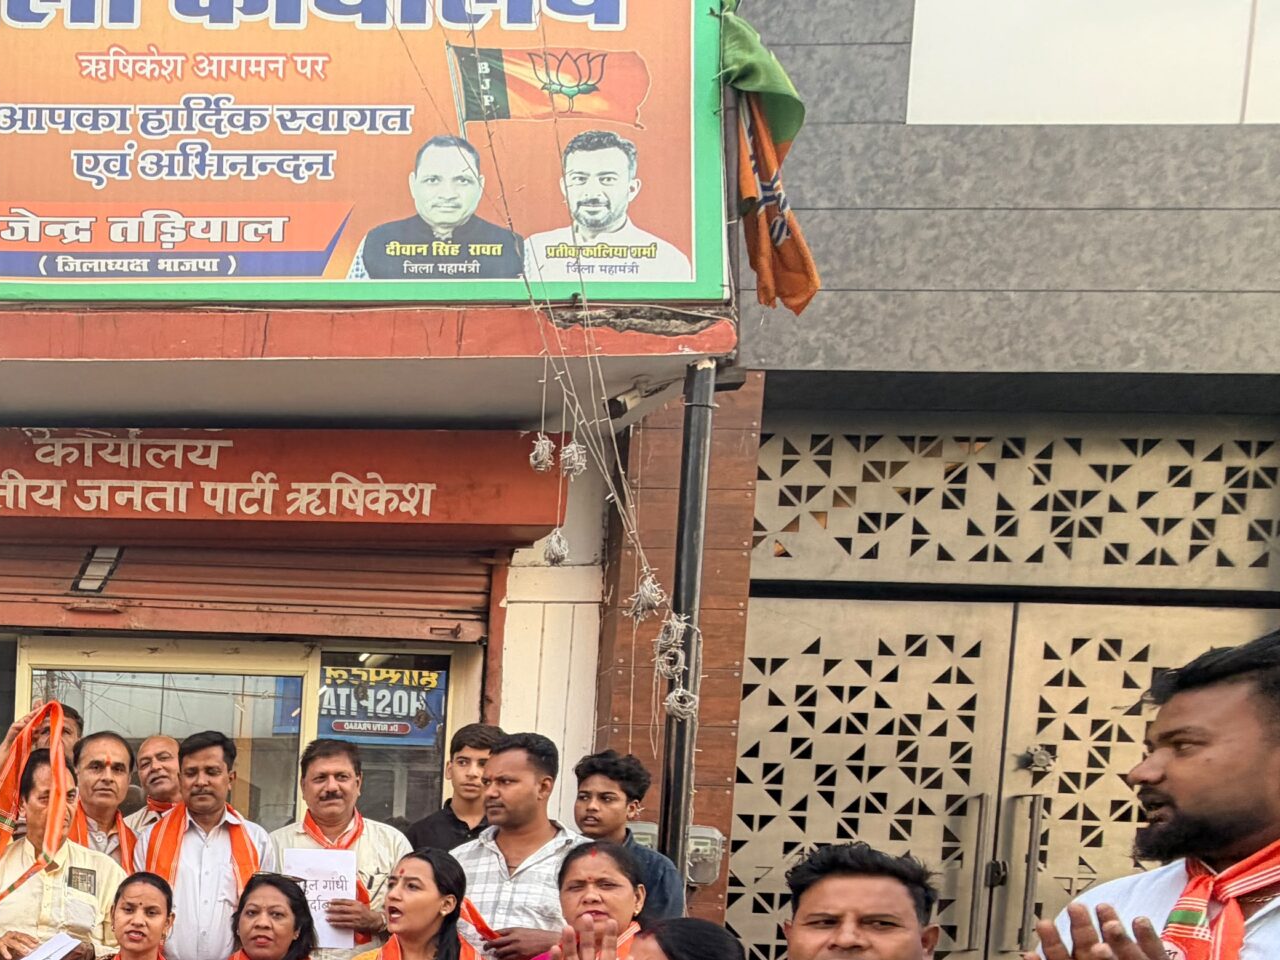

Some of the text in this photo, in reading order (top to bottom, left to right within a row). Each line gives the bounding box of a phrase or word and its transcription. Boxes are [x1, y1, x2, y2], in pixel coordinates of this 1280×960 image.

[80, 47, 329, 80] ऋषिकेश आगमन पर
[477, 61, 494, 106] BJP
[138, 95, 269, 136] हार्दिक
[277, 104, 414, 134] स्वागत
[73, 141, 334, 187] एवं अभिनन्दन
[106, 209, 290, 249] तड़ियाल
[157, 257, 220, 273] भाजपा
[385, 241, 503, 256] दीवान सिंह रावत
[581, 243, 629, 258] कालिया
[631, 243, 658, 258] शर्मा
[403, 260, 480, 275] जिला महामंत्री
[566, 261, 639, 275] जिला महामंत्री
[33, 430, 233, 470] कार्यालय
[74, 478, 193, 514] जनता
[200, 473, 279, 516] पार्टी
[286, 472, 436, 517] ऋषिकेश
[322, 875, 349, 891] गांधी
